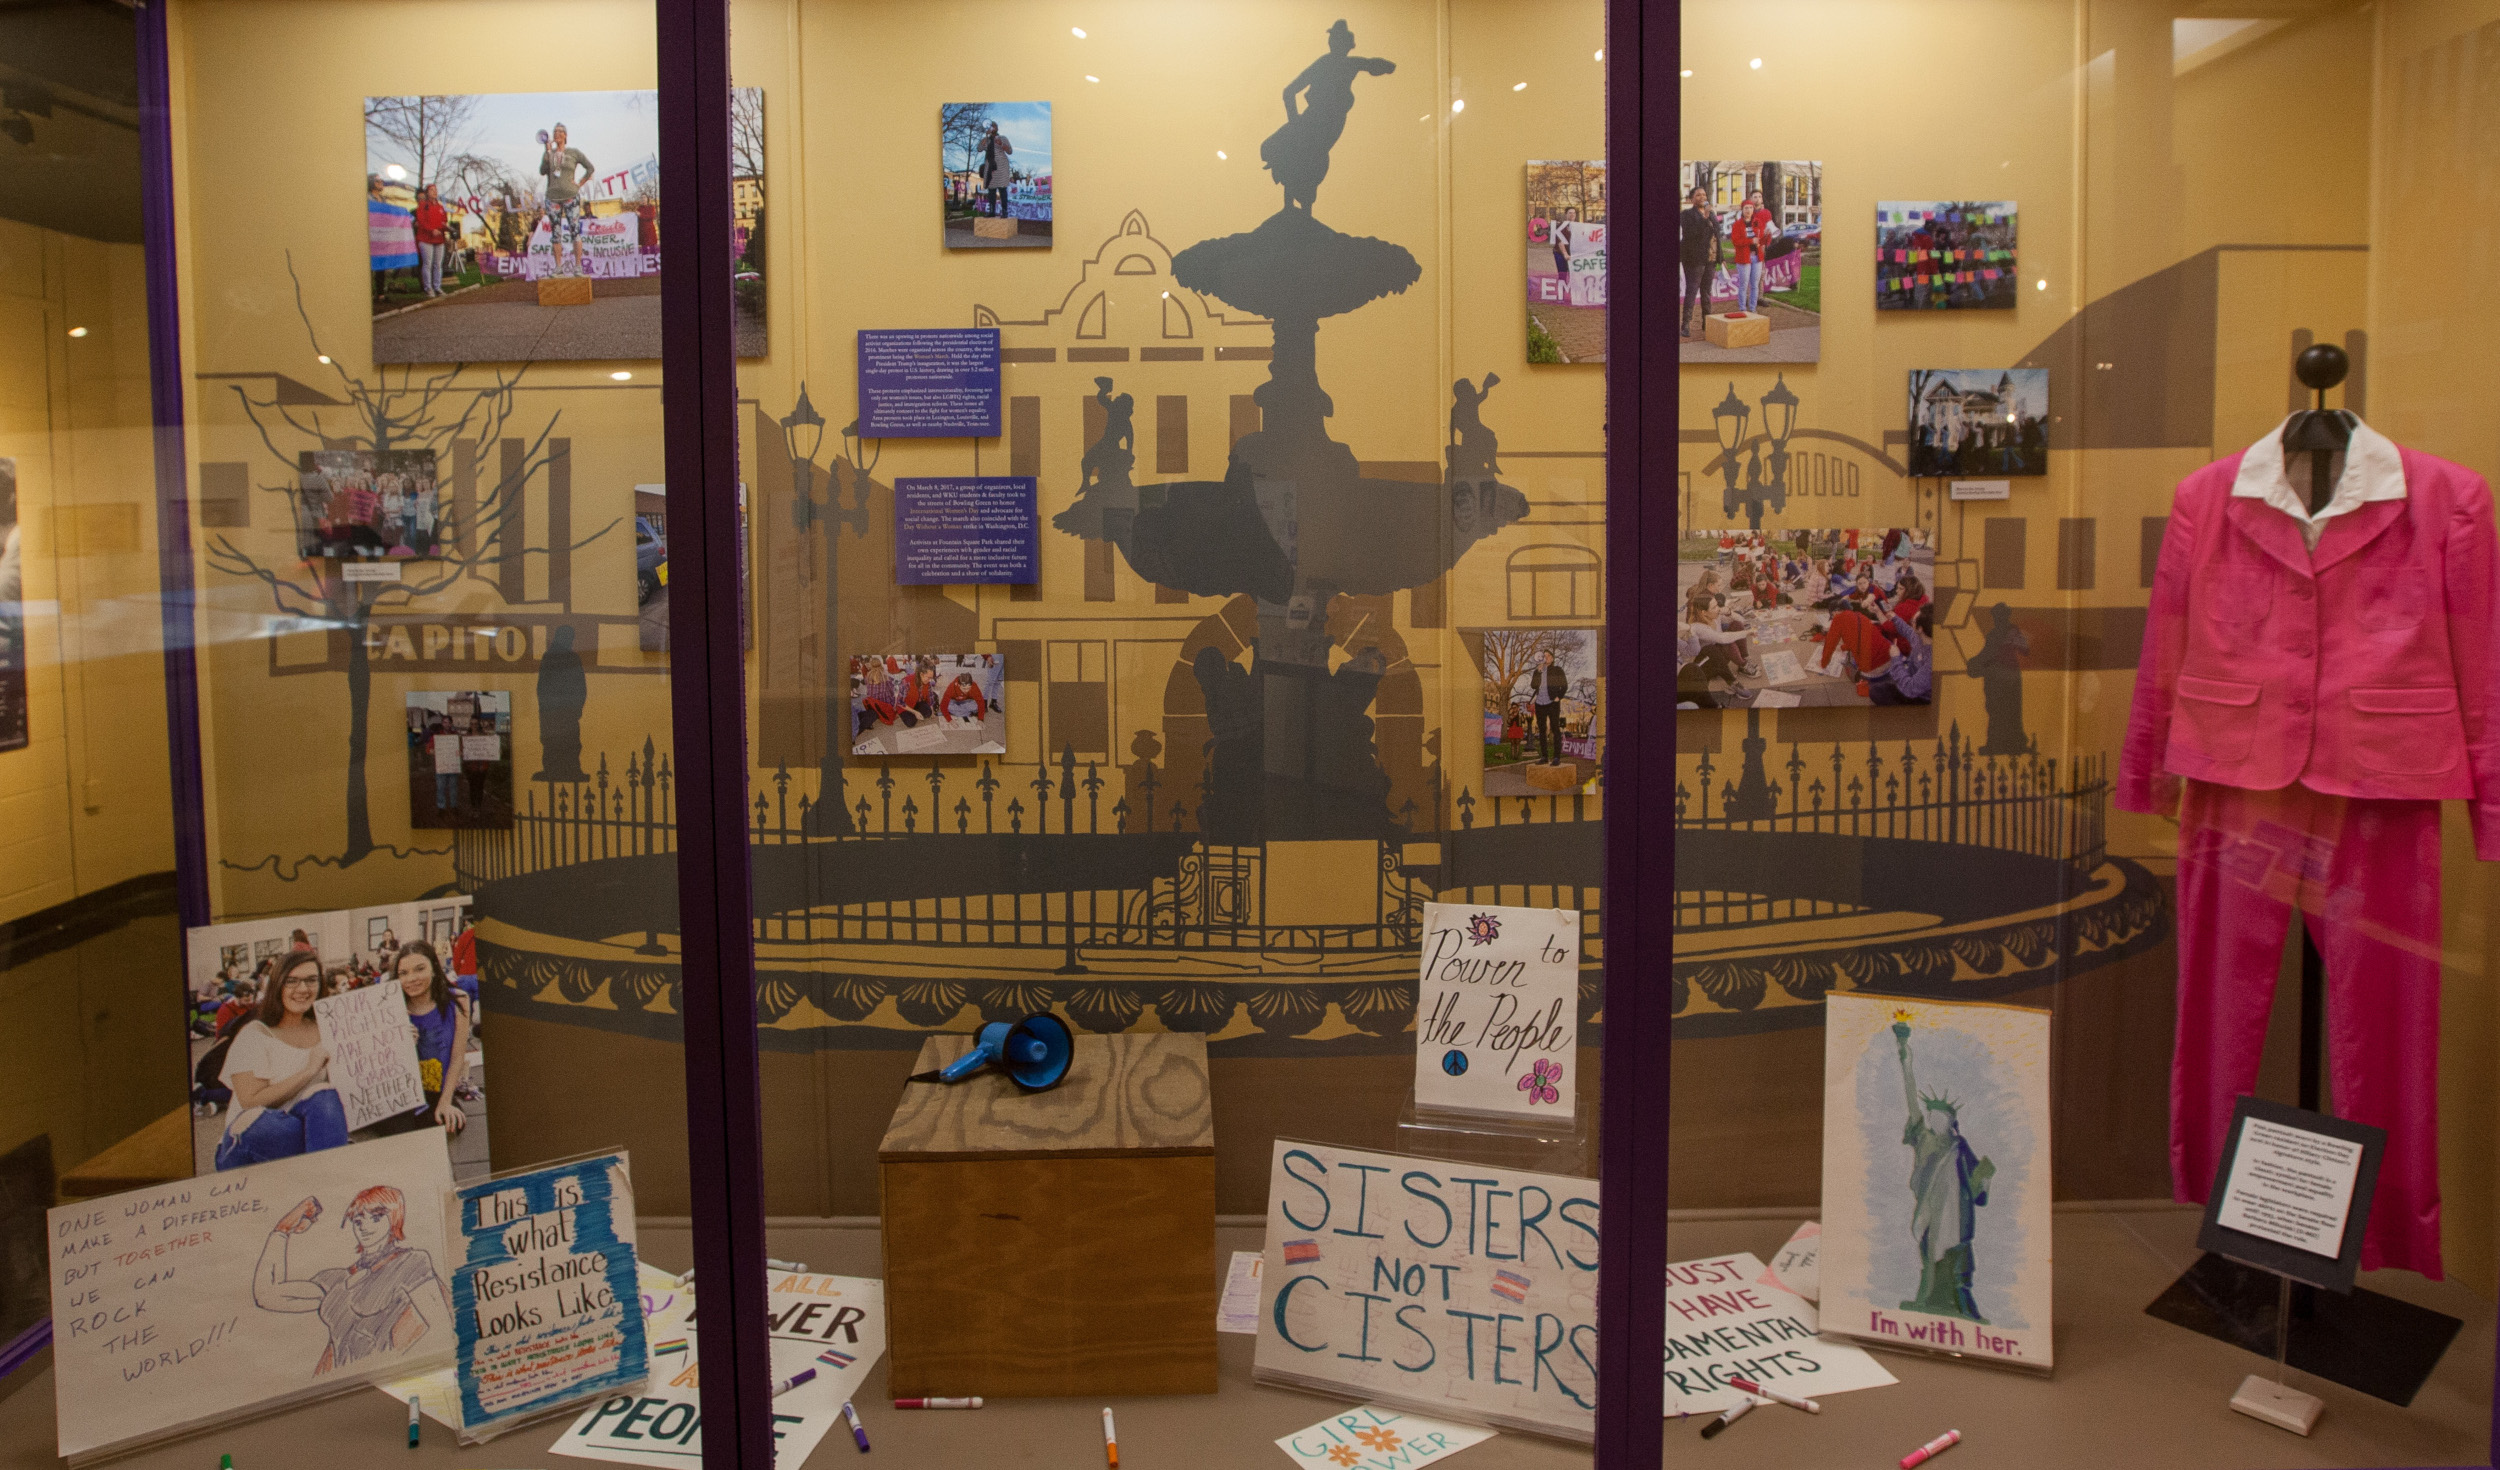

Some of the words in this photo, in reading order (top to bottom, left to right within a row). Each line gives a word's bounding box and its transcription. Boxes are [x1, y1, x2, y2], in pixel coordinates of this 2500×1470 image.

[1425, 928, 1528, 988] Power
[1540, 933, 1570, 964] to
[371, 1025, 406, 1048] NOT
[1420, 991, 1474, 1047] the
[1476, 992, 1573, 1076] People
[355, 1103, 386, 1126] ARE
[57, 1210, 107, 1239] ONE
[124, 1192, 191, 1219] WOMAN
[209, 1177, 249, 1198] CAN
[60, 1232, 114, 1259] MAKE
[135, 1222, 146, 1239] A
[162, 1197, 269, 1231] DIFFERENCE,
[473, 1193, 529, 1228] This
[554, 1184, 580, 1208] is
[1282, 1149, 1600, 1271] SISTERS
[508, 1211, 571, 1257] what
[62, 1261, 100, 1286] BUT
[113, 1231, 213, 1267] TOGETHER
[473, 1251, 608, 1302] Resistance
[1373, 1256, 1461, 1301] NOT
[70, 1290, 101, 1308] WE
[133, 1266, 176, 1290] CAN
[773, 1274, 842, 1297] ALL
[1669, 1288, 1772, 1322] HAVE
[69, 1299, 148, 1338] ROCK
[475, 1300, 543, 1340] Looks
[557, 1282, 614, 1318] Like
[1871, 1311, 1899, 1337] I'm
[1905, 1320, 1964, 1348] with
[1976, 1326, 2023, 1356] her.
[102, 1328, 160, 1356] THE
[123, 1317, 239, 1382] WORLD!!!
[1273, 1275, 1598, 1410] CISTERS
[1665, 1350, 1822, 1396] RIGHTS
[1291, 1408, 1402, 1458] GIRL
